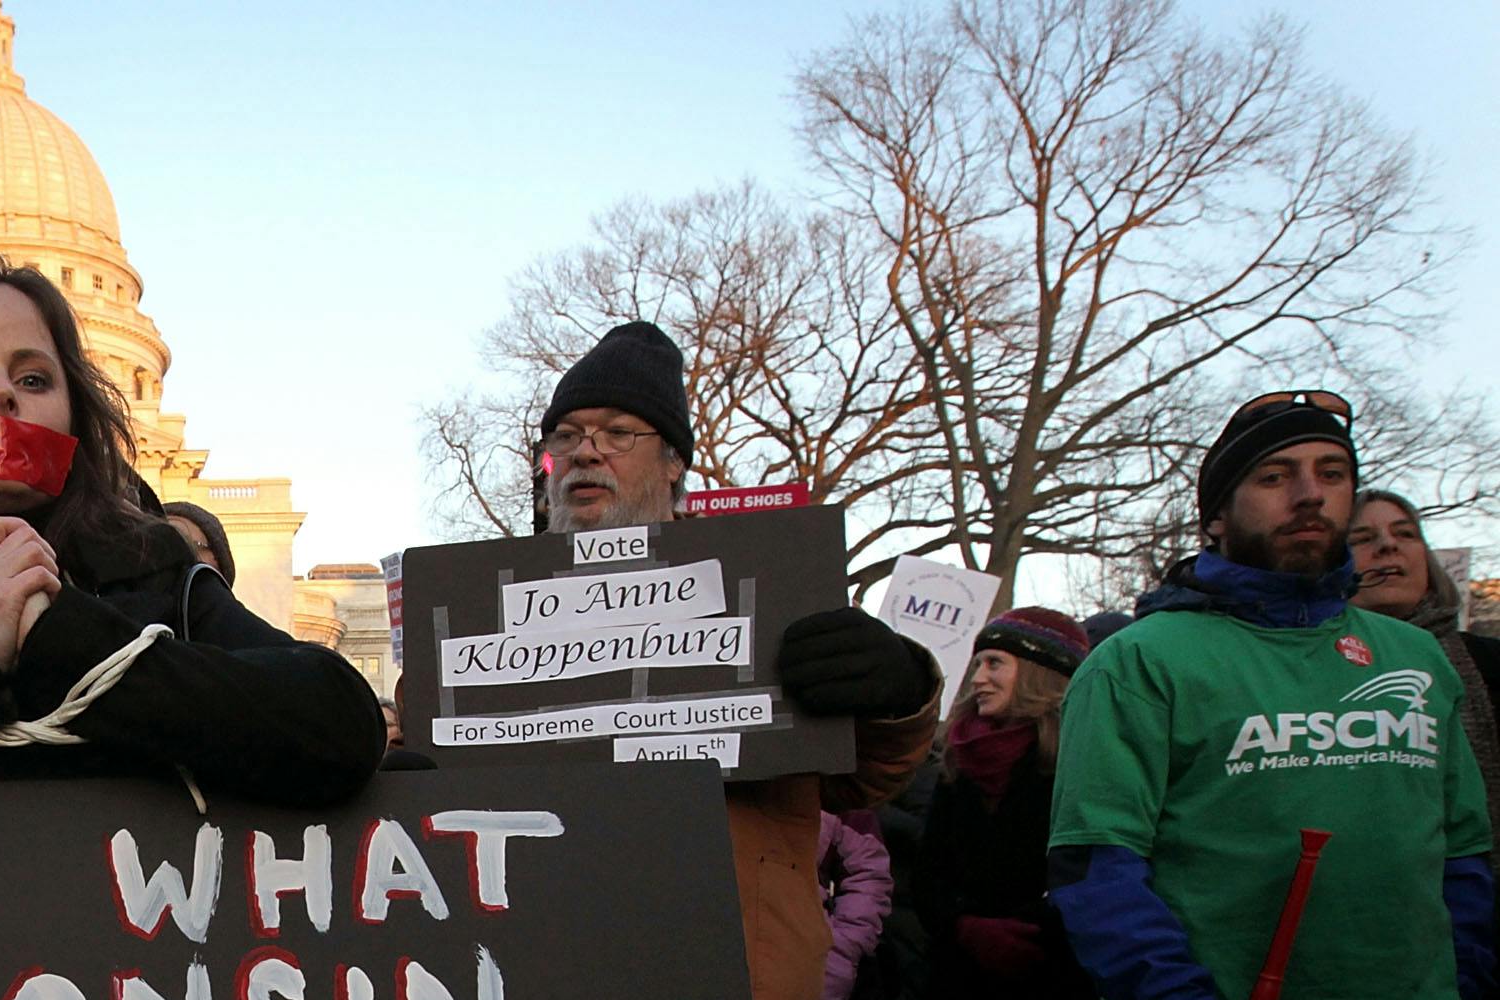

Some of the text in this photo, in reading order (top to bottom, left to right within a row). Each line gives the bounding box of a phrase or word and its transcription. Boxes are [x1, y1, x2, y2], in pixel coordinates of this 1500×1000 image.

[691, 492, 793, 511] IN OUR SHOES
[576, 535, 645, 561] Vote
[512, 576, 698, 627] Jo Anne
[903, 594, 963, 626] MTI
[453, 622, 743, 682] Kloppenburg
[453, 703, 764, 743] For Supreme Court Justice
[1226, 709, 1439, 761] AFSCME
[1224, 760, 1254, 777] We
[1259, 753, 1309, 771] Make
[1313, 750, 1388, 767] America
[108, 810, 565, 943] WHAT
